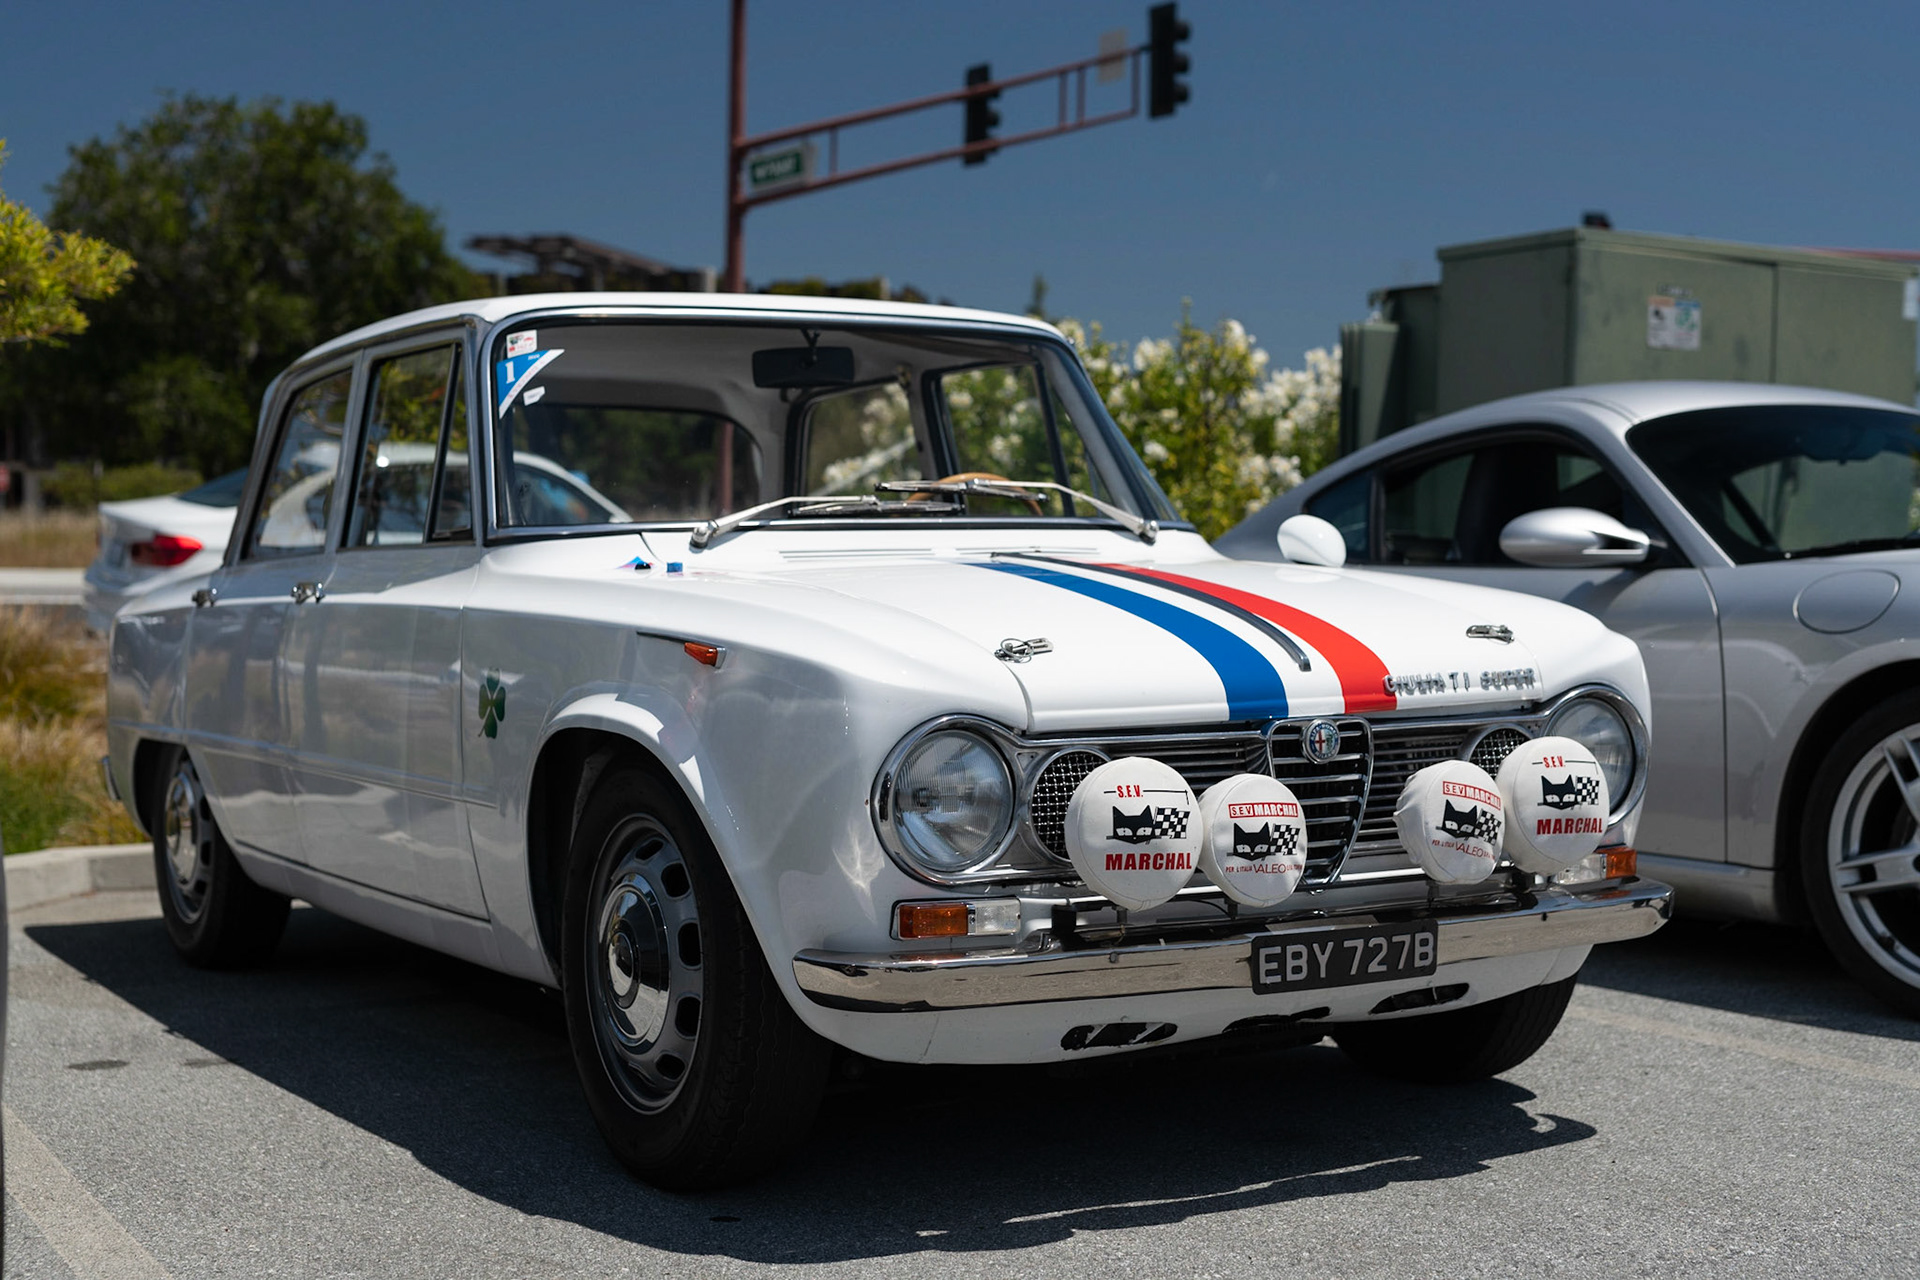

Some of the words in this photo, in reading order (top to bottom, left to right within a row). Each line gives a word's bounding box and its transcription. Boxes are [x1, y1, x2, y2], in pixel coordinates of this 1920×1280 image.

[1480, 668, 1536, 691] SUPER
[1117, 785, 1143, 798] S.E.V.
[1253, 803, 1298, 816] MARCHAL
[1537, 817, 1603, 835] MARCHAL
[1455, 840, 1484, 858] VALEO
[1105, 852, 1192, 871] MARCHAL
[1253, 863, 1287, 874] VALEO
[1259, 941, 1335, 984] EBY
[1343, 932, 1435, 976] 727B
